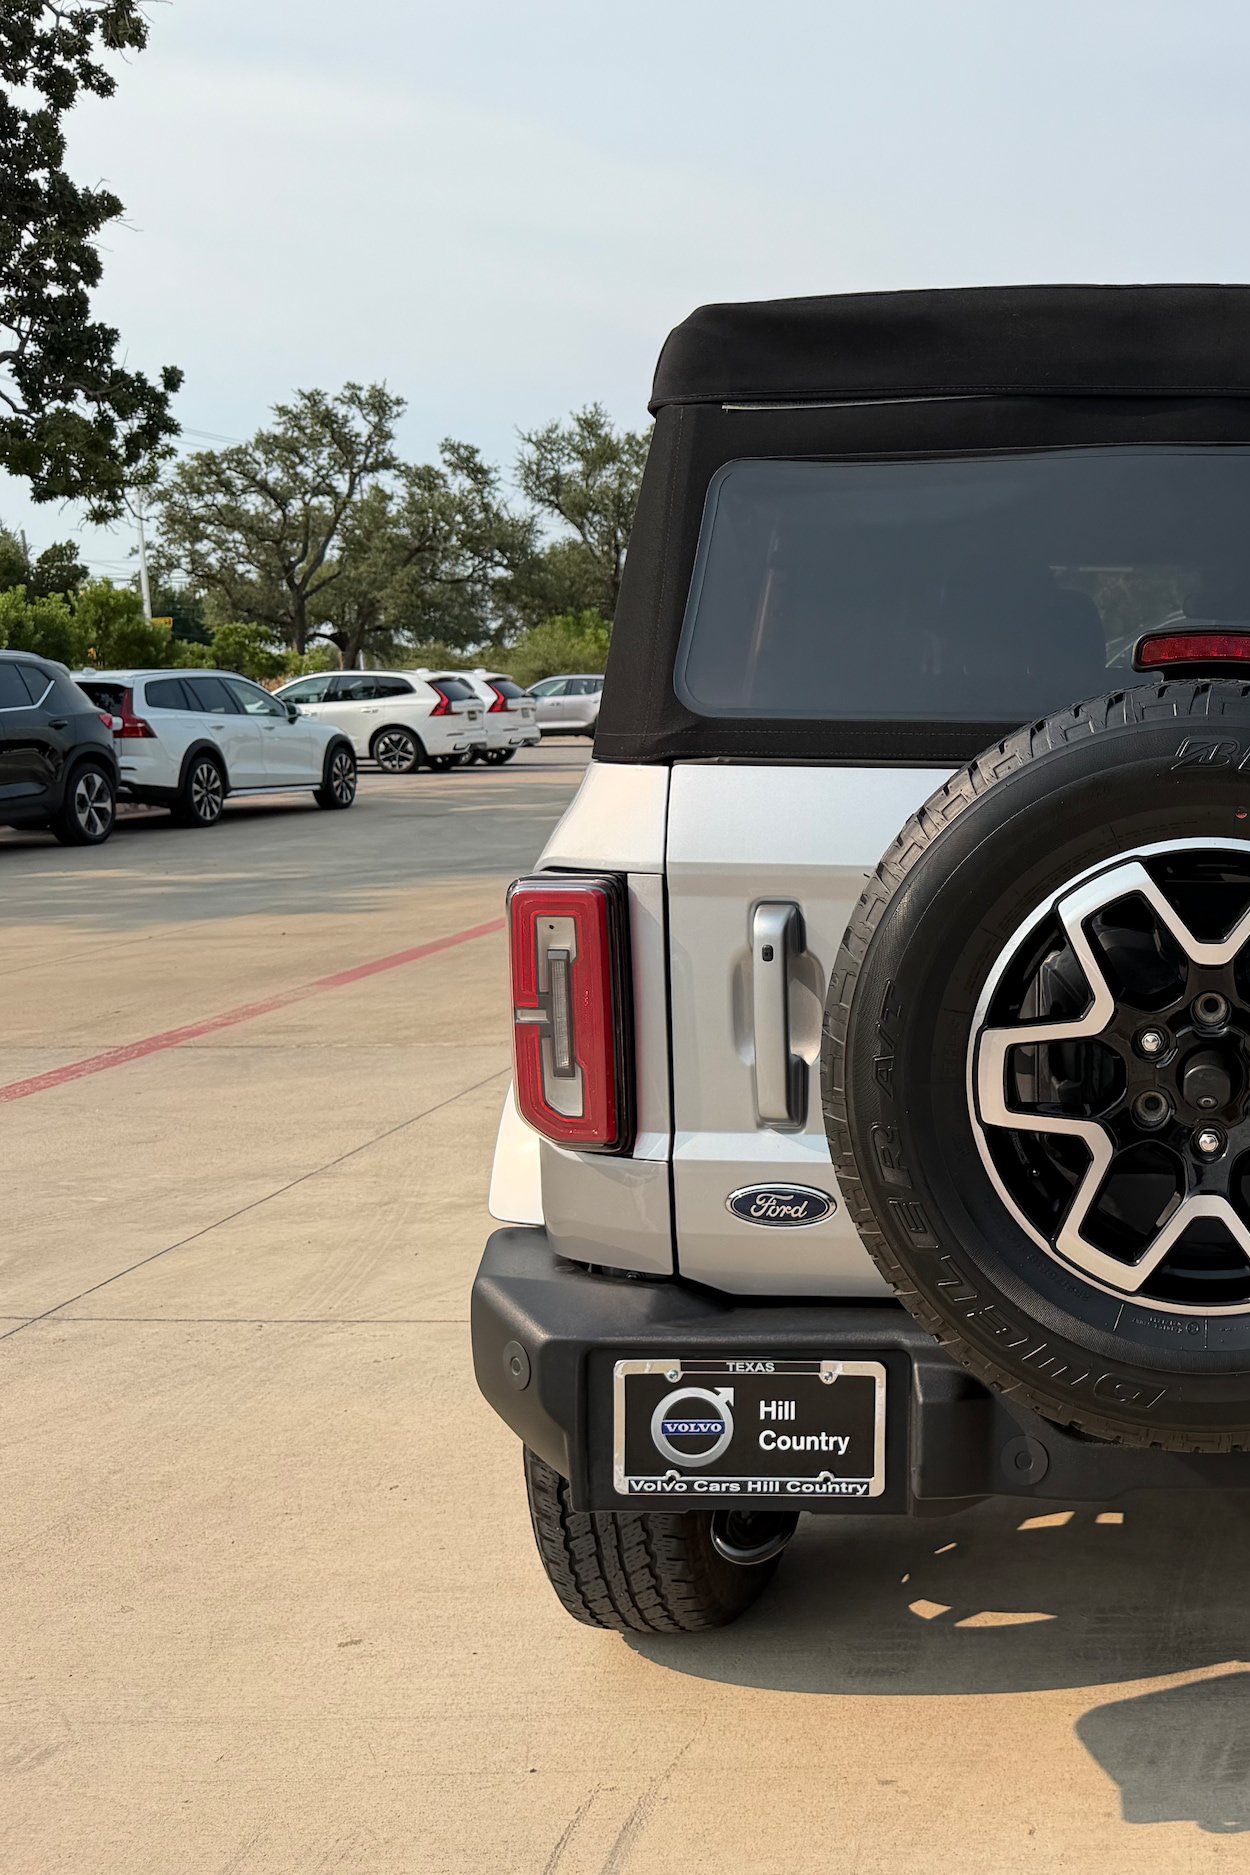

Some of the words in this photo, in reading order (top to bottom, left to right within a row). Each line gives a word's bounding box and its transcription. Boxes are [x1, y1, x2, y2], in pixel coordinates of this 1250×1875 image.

[750, 1193, 808, 1218] Ford
[726, 1362, 776, 1372] TEXAS
[759, 1400, 796, 1421] Hill
[664, 1423, 723, 1433] VOLVO
[758, 1430, 850, 1455] Country
[629, 1479, 689, 1493] Volvo
[693, 1480, 741, 1492] Cars
[748, 1481, 780, 1493] Hill
[786, 1482, 868, 1496] Country
